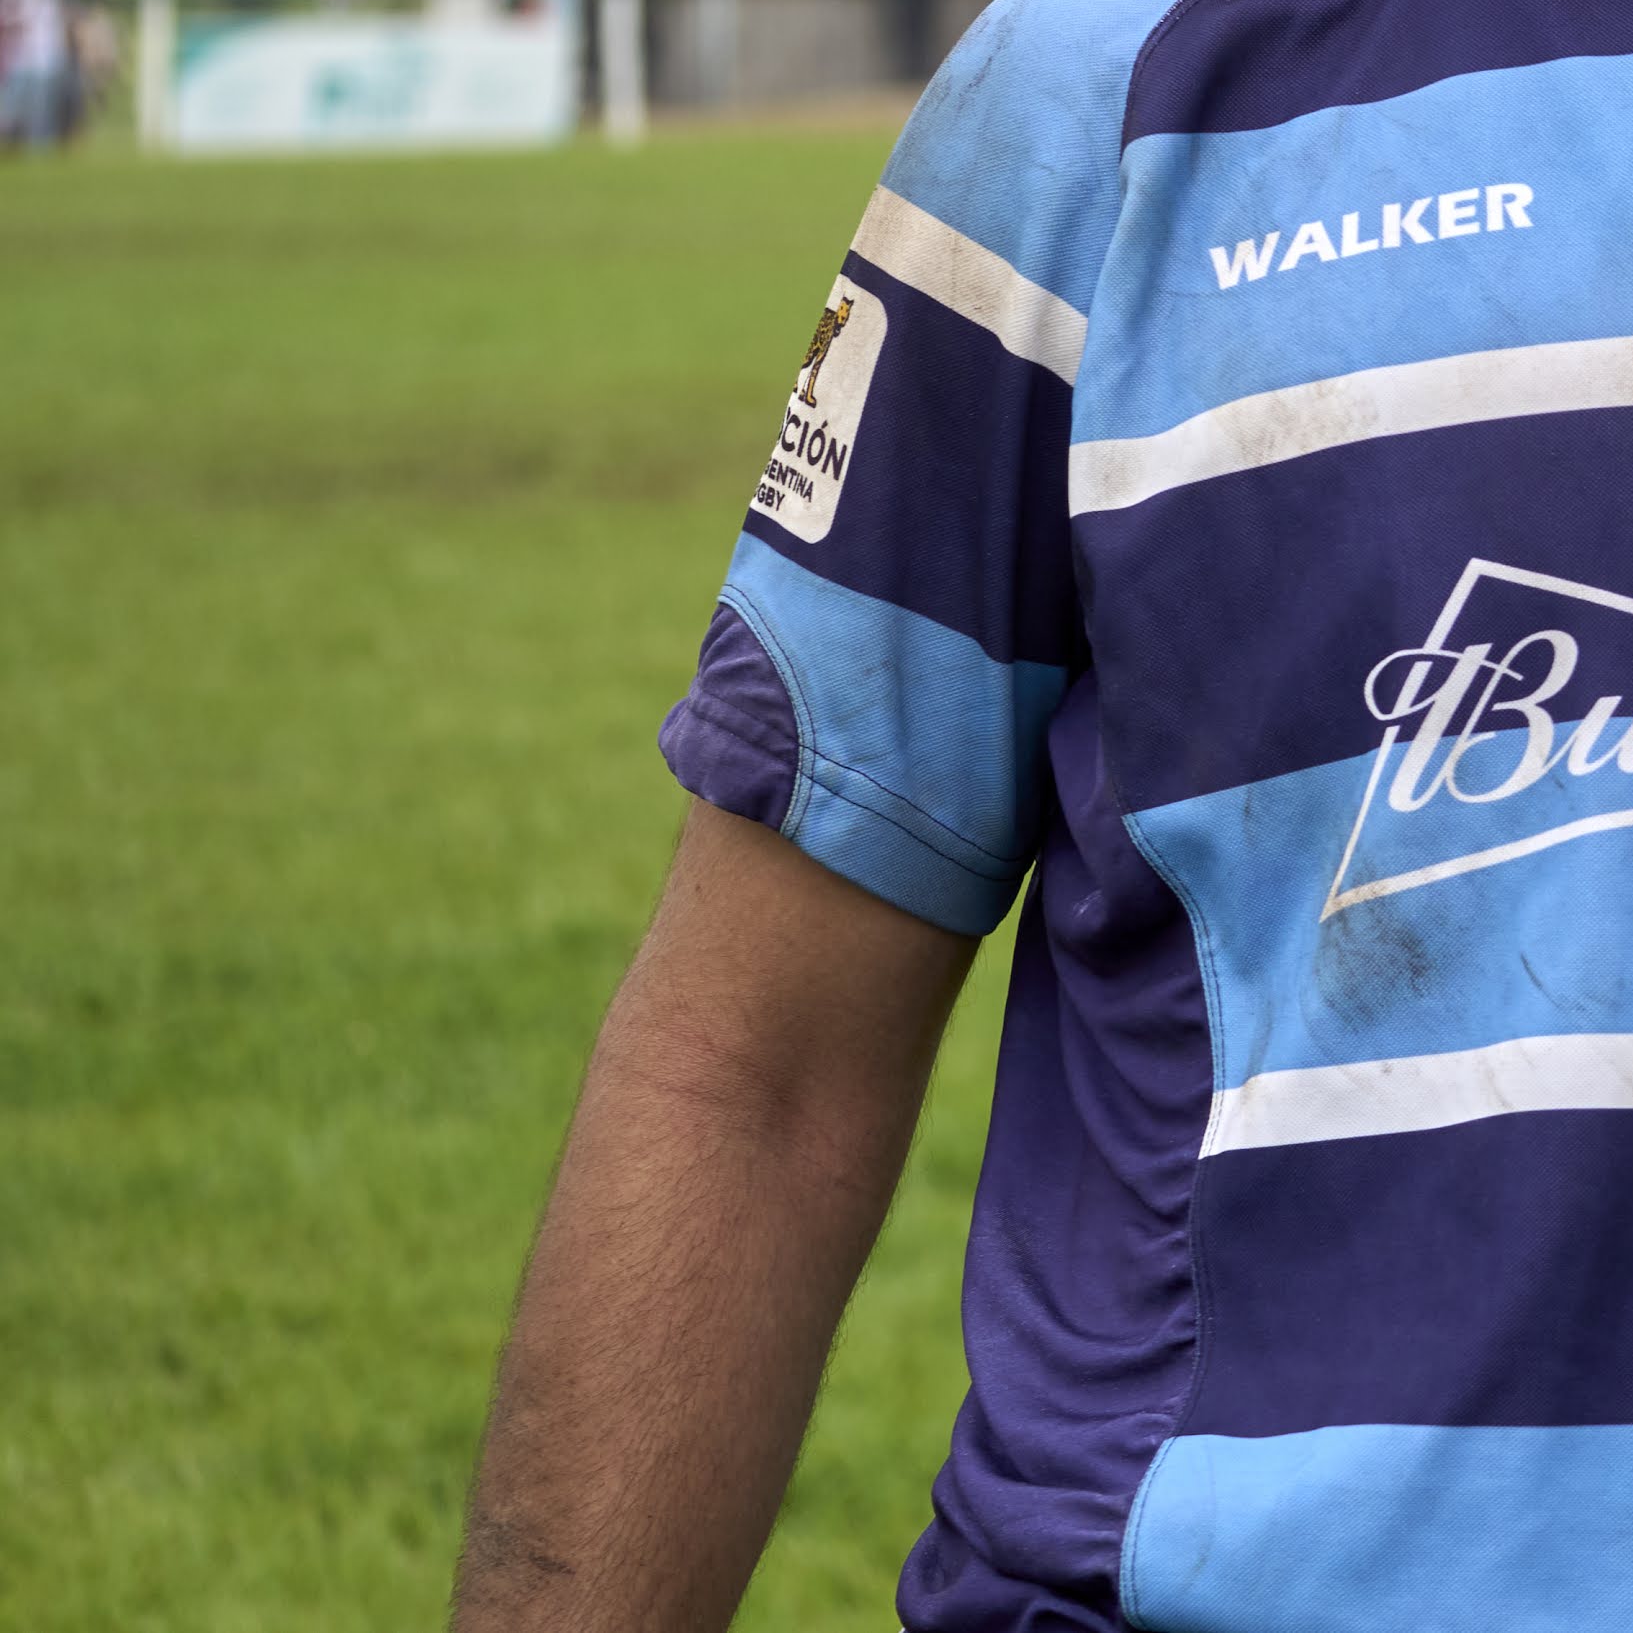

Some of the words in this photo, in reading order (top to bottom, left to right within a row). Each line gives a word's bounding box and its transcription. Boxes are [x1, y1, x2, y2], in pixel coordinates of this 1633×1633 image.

[1208, 182, 1535, 291] WALKER
[779, 407, 848, 481] CIÓN
[754, 482, 786, 511] GBY
